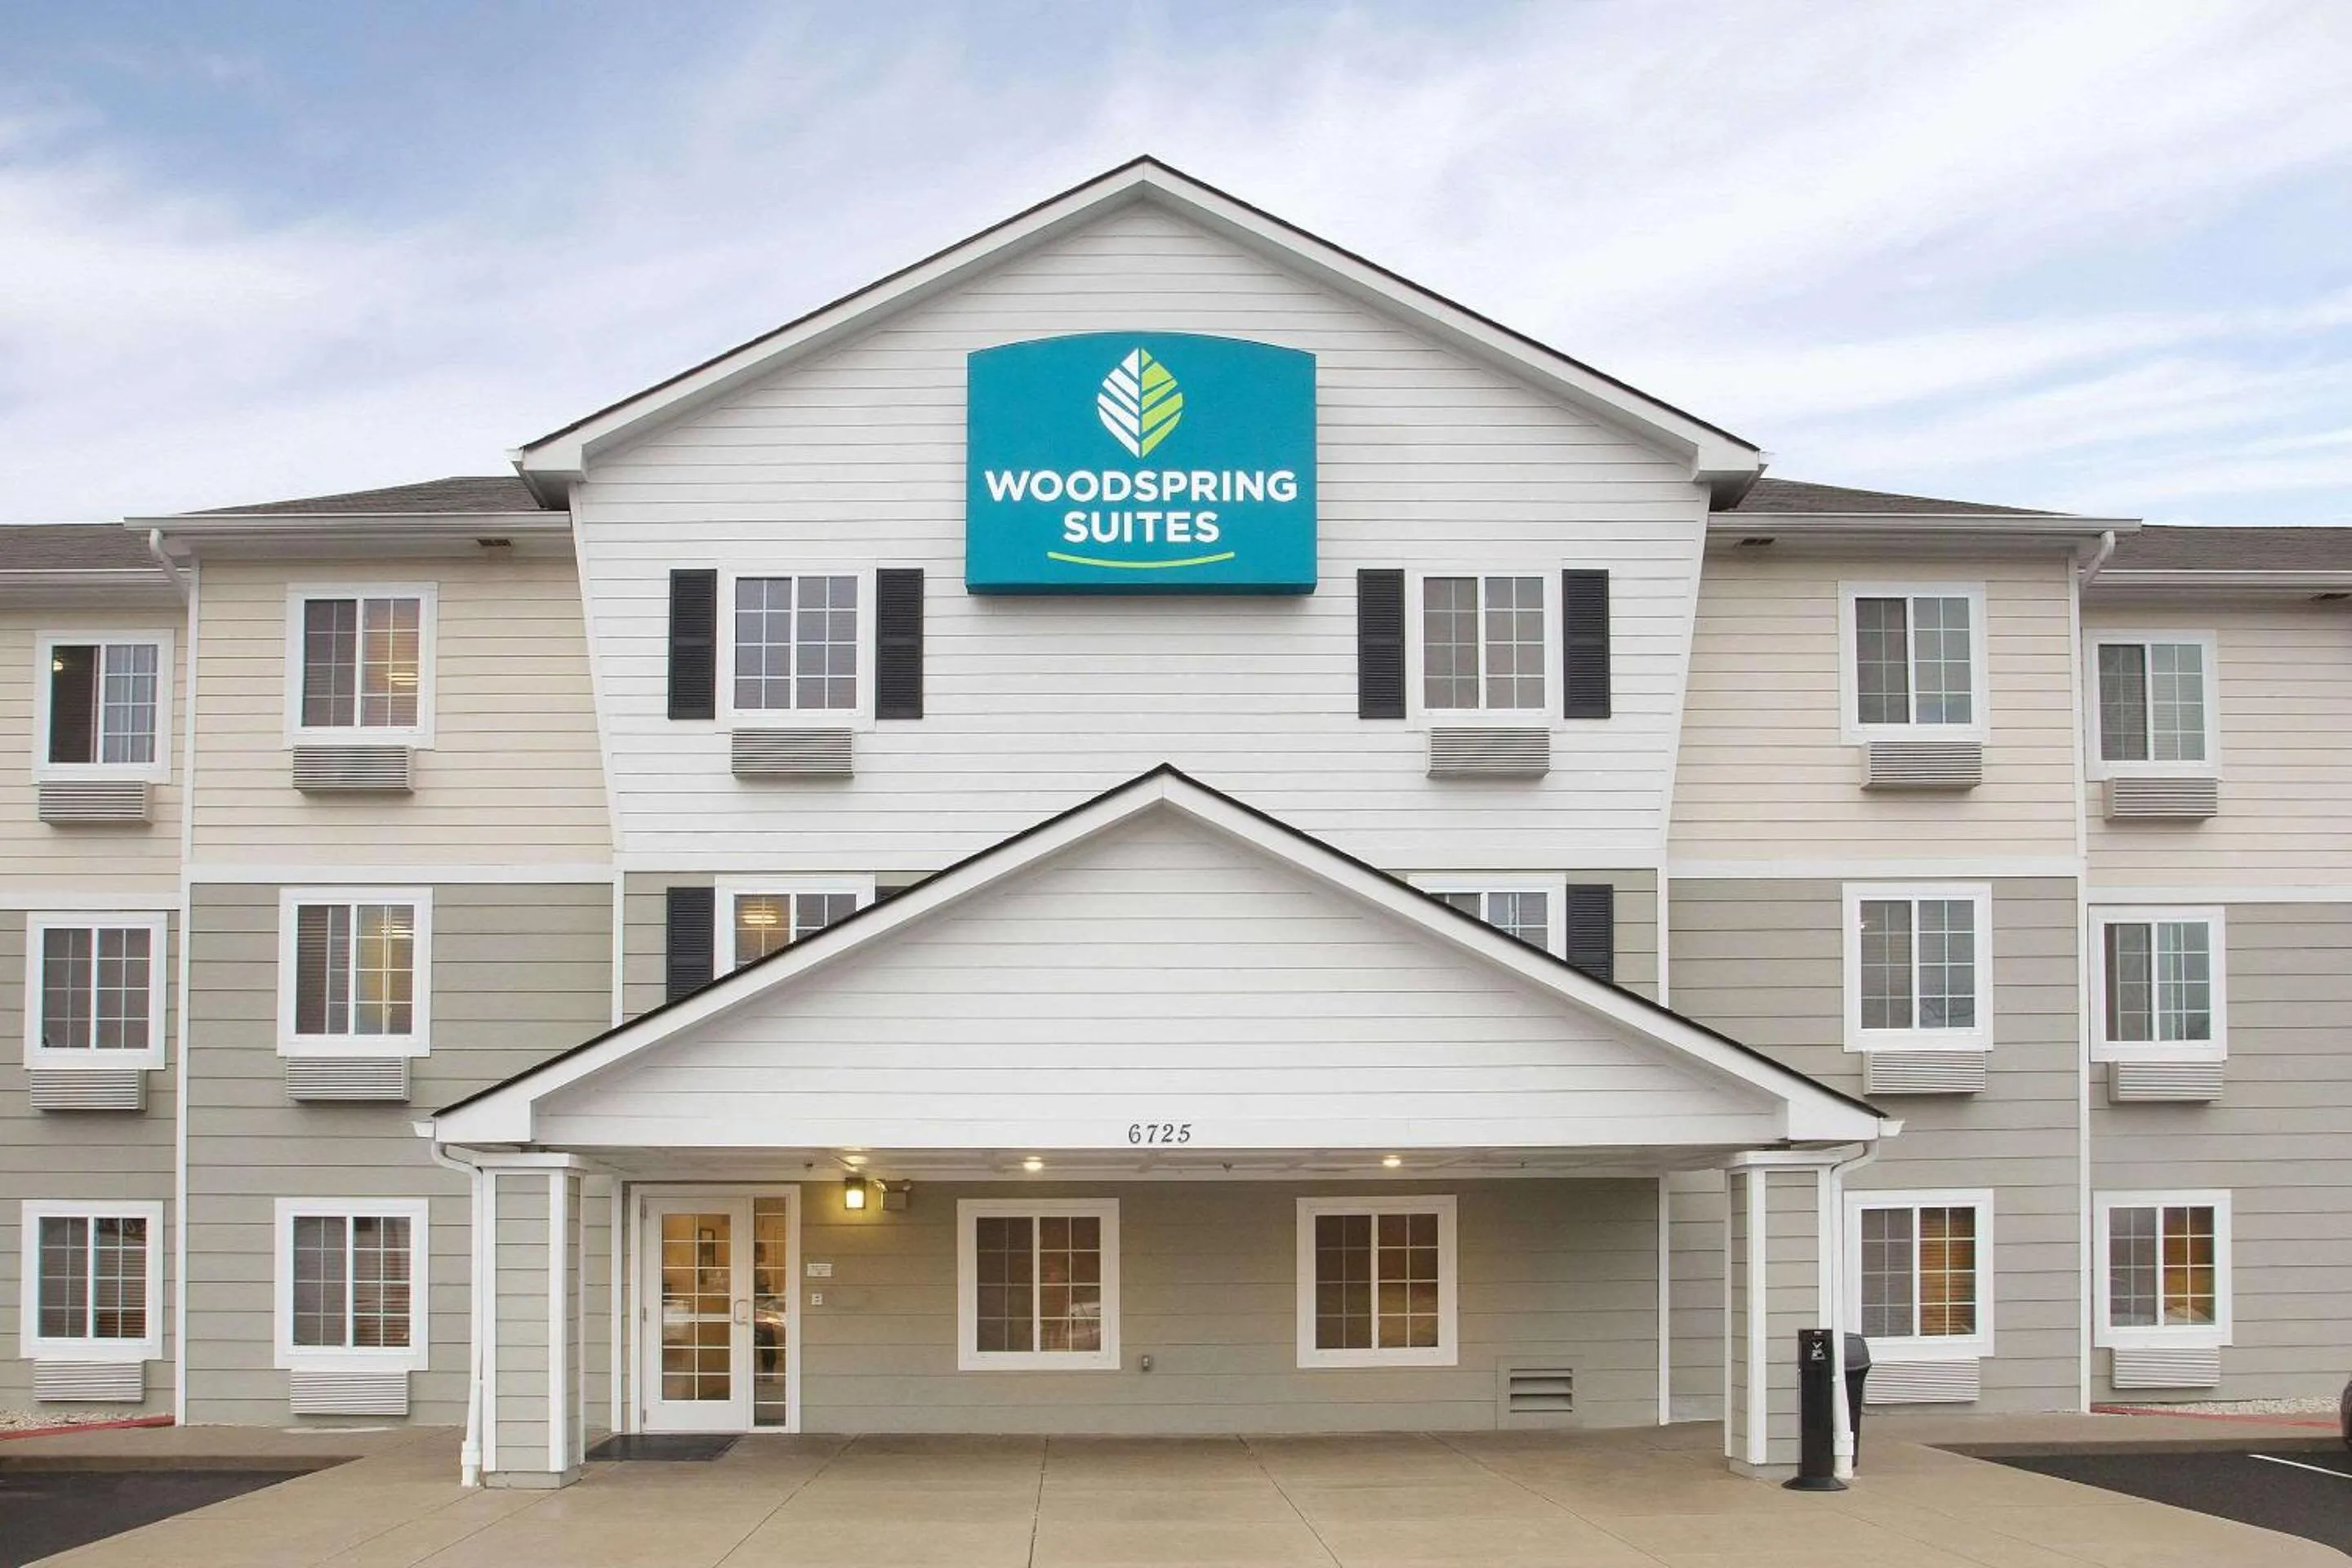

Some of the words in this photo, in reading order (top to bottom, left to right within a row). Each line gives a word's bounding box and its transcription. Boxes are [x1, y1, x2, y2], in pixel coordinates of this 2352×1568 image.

[984, 470, 1298, 502] WOODSPRING
[1063, 510, 1219, 543] SUITES
[1128, 1123, 1192, 1144] 6725
